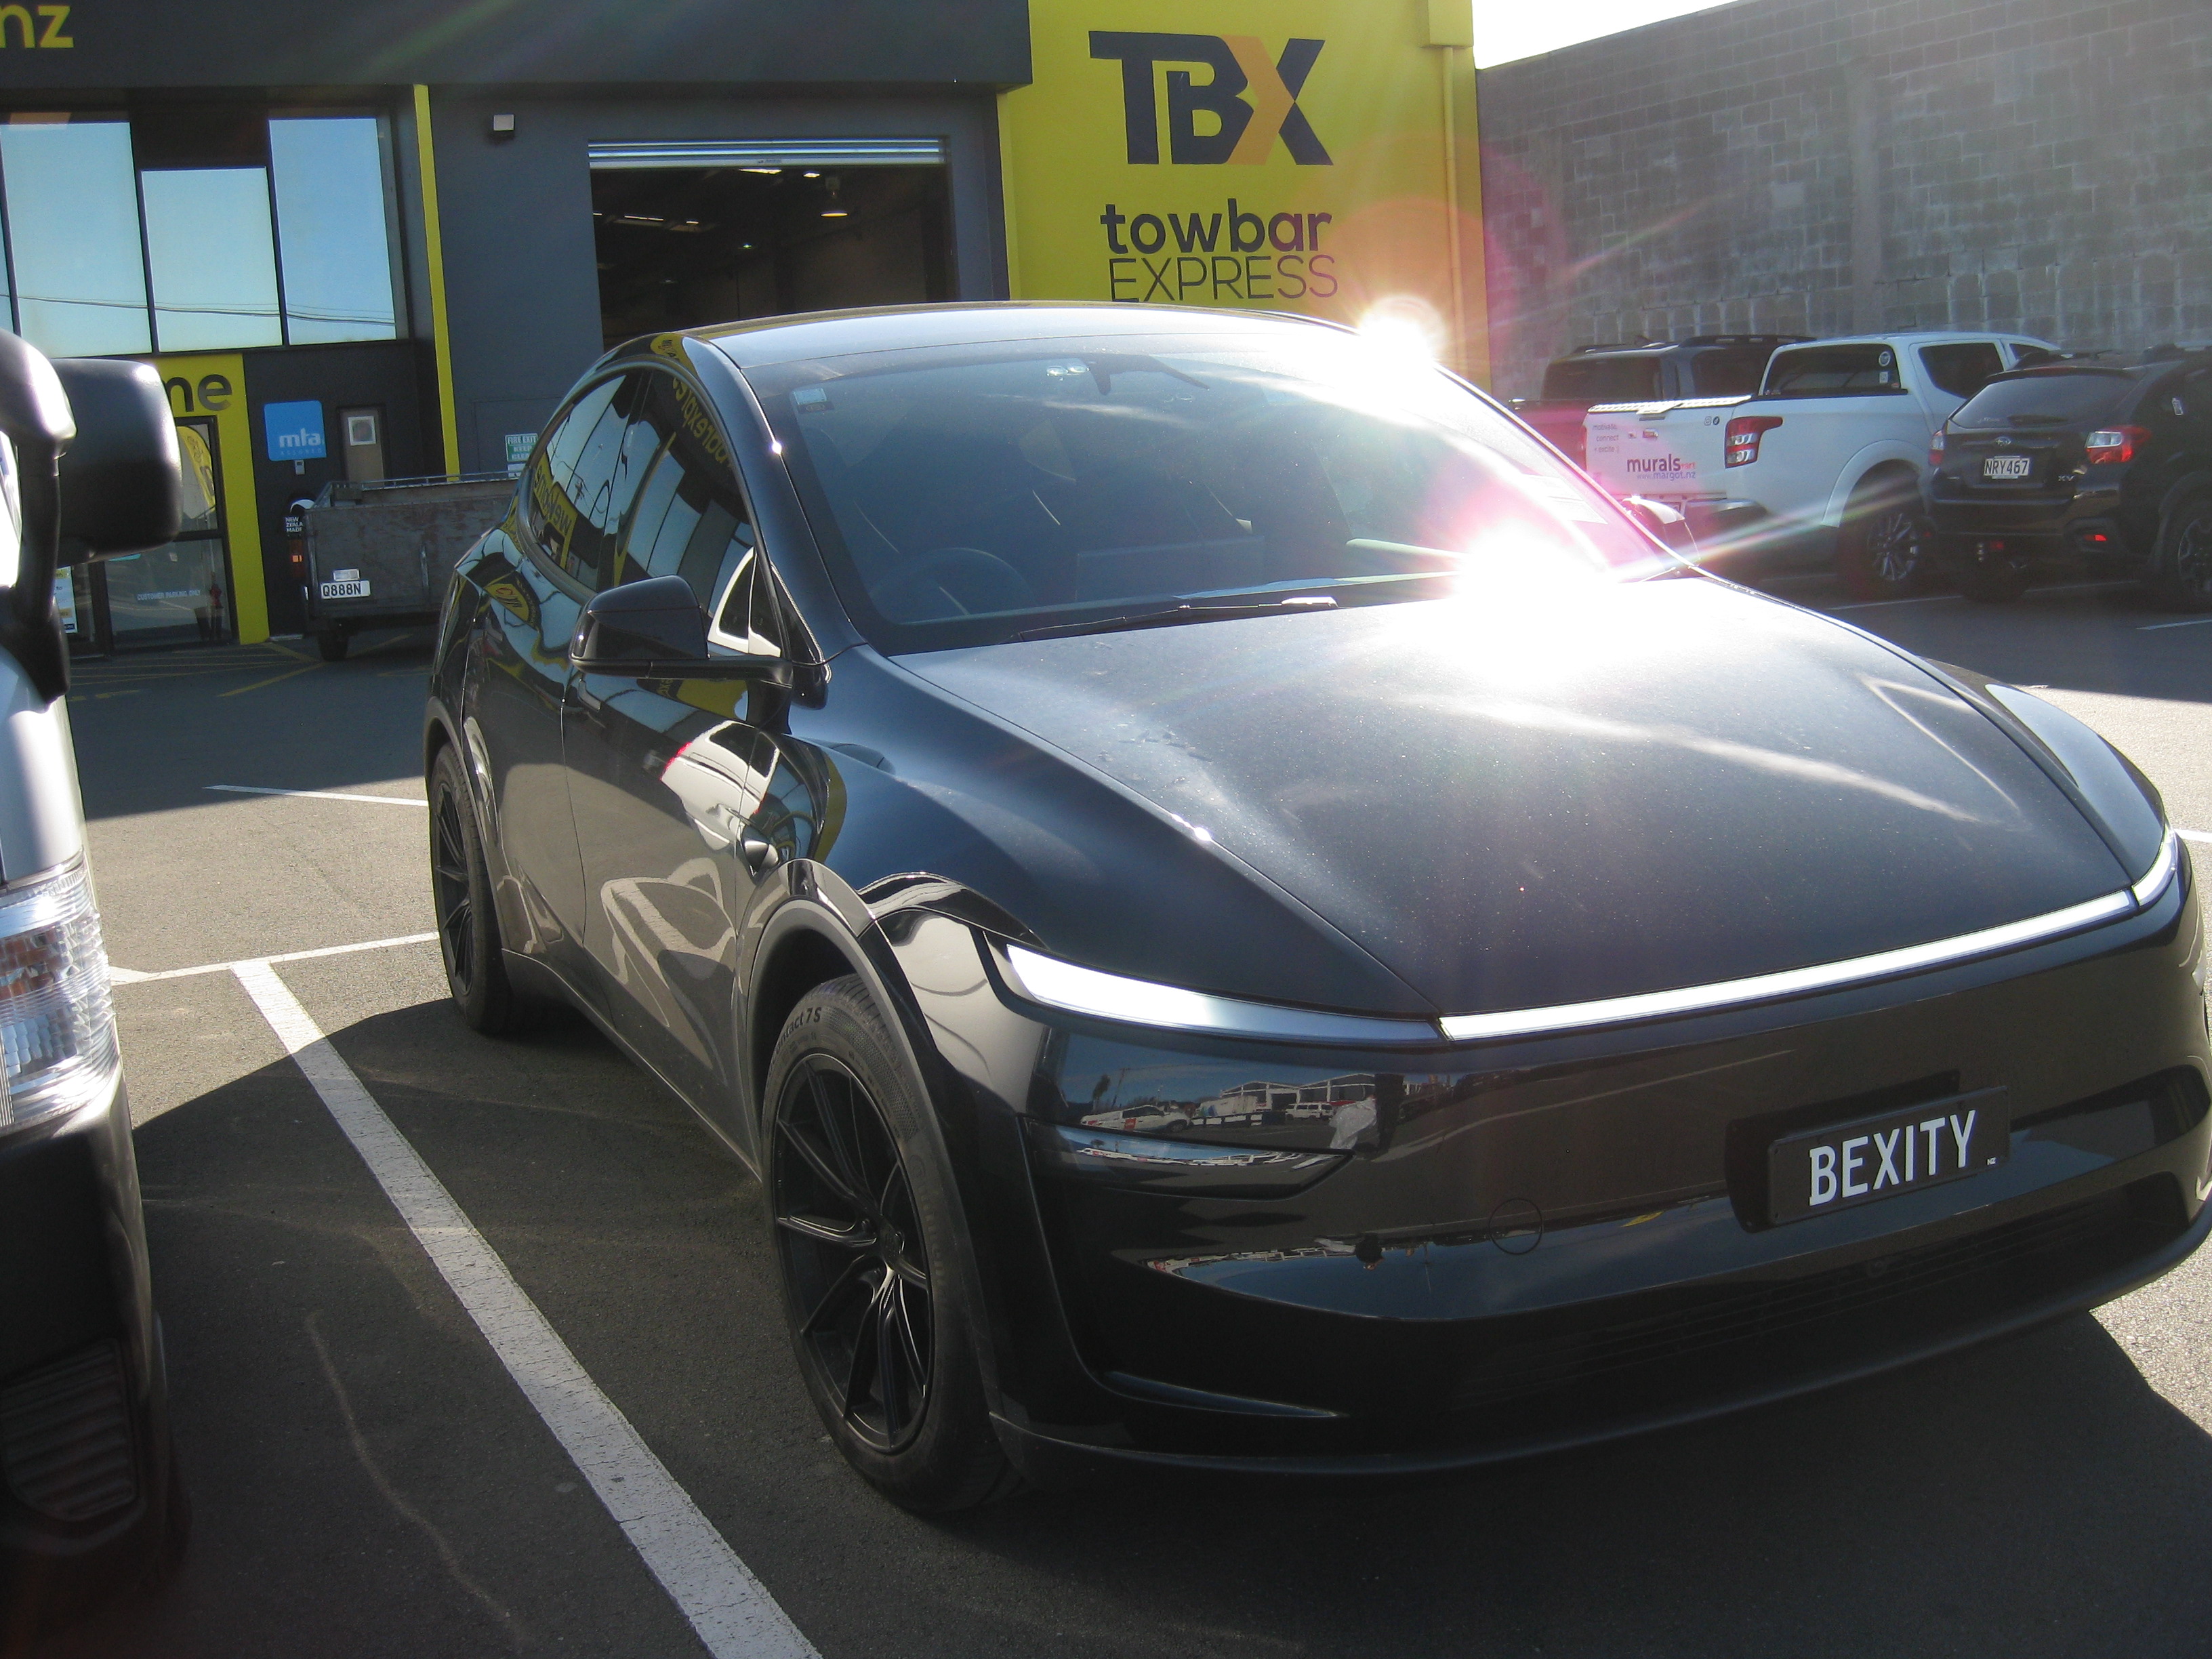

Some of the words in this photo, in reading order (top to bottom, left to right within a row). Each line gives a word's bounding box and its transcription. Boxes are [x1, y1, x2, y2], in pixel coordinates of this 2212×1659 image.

[1088, 30, 1334, 165] TBX
[1100, 198, 1332, 254] towbar
[1109, 255, 1338, 302] EXPRESS
[279, 428, 322, 447] mta
[523, 434, 537, 444] EXIT
[1627, 453, 1681, 472] murals
[1809, 1109, 1976, 1206] BEXITY
